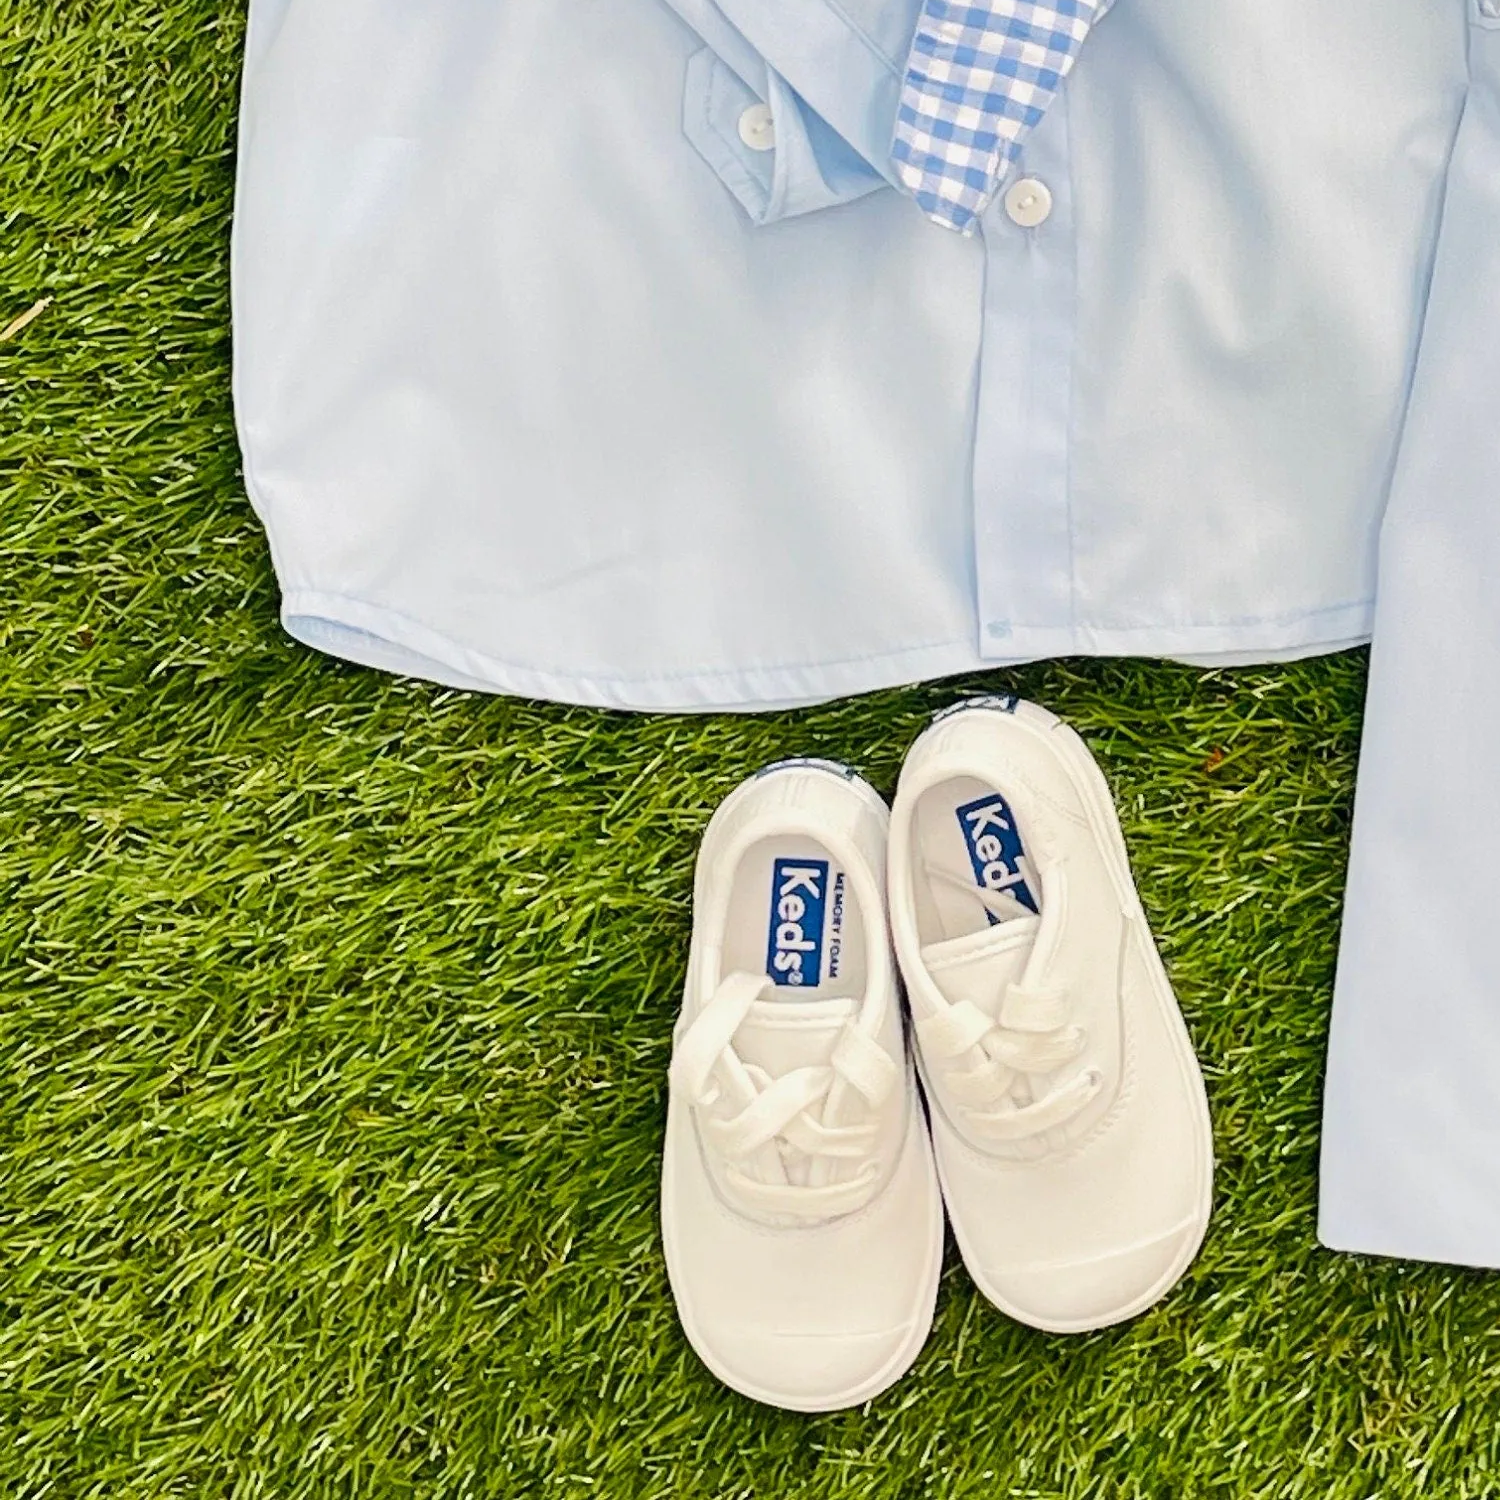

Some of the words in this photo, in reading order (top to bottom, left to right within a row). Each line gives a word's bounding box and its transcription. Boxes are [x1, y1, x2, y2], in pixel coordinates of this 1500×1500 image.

[965, 801, 1026, 900] Ked
[832, 871, 845, 934] MEMORY
[828, 938, 842, 978] FOAM
